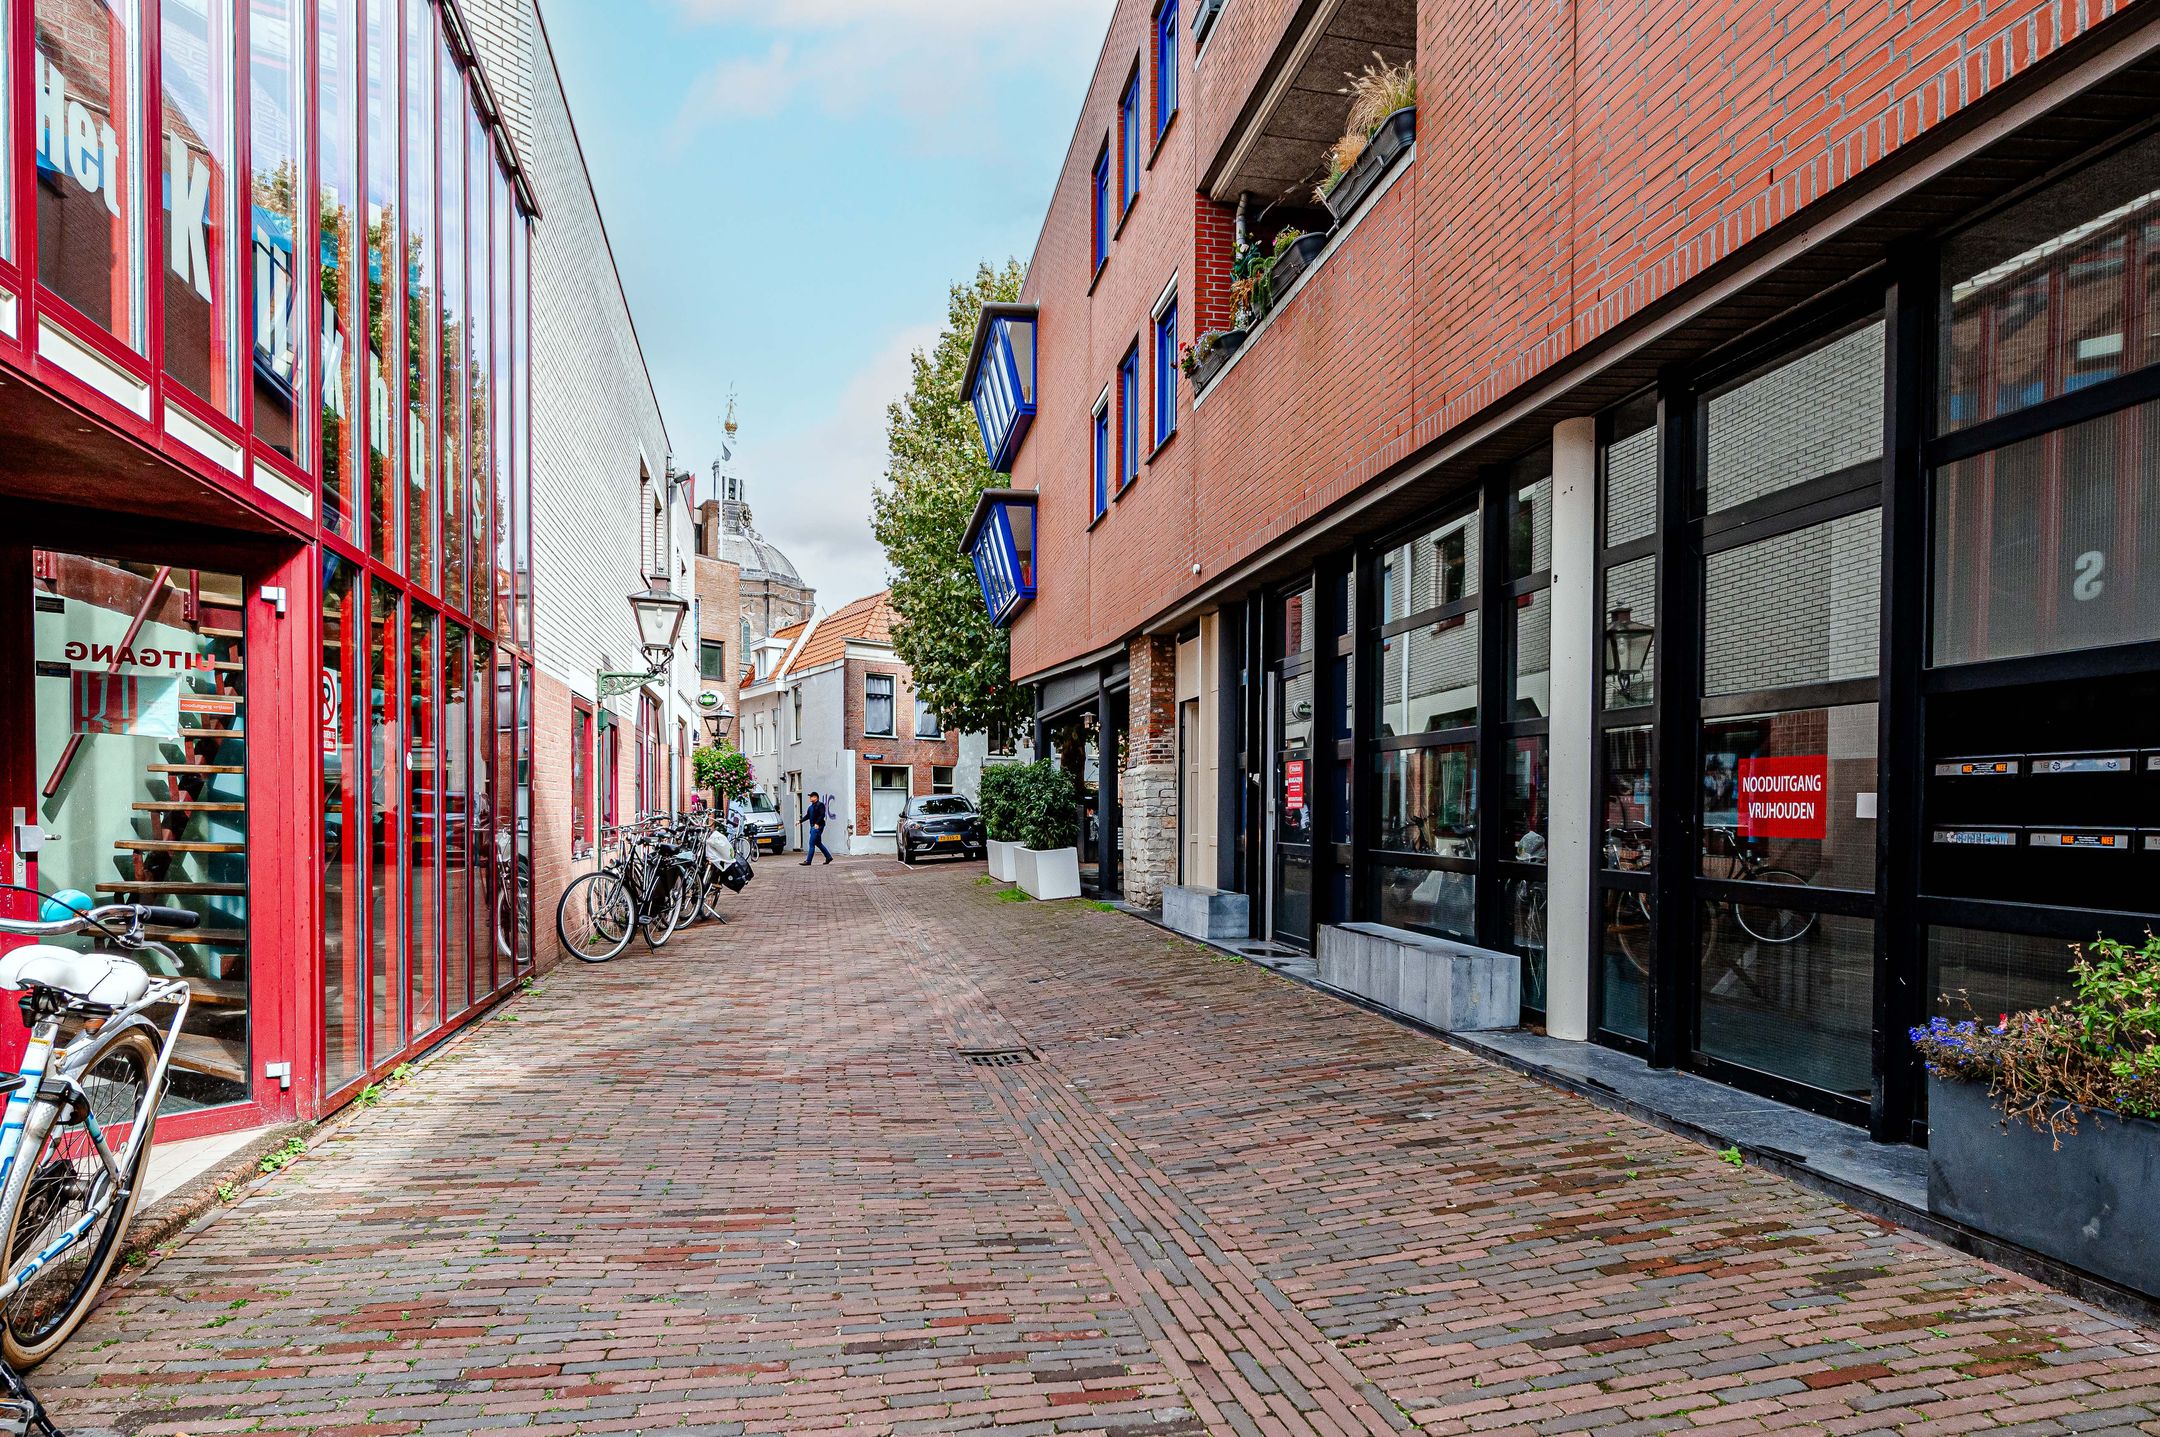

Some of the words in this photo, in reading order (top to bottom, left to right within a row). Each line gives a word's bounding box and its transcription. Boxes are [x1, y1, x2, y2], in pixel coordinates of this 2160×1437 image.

[35, 48, 121, 219] Het
[1962, 764, 1973, 773] NEE
[1995, 763, 2007, 772] NEE
[1742, 774, 1822, 793] NOODUITGANG
[1748, 802, 1815, 820] VRIJHOUDEN
[2062, 835, 2074, 844] NEE
[2101, 836, 2114, 845] NEE
